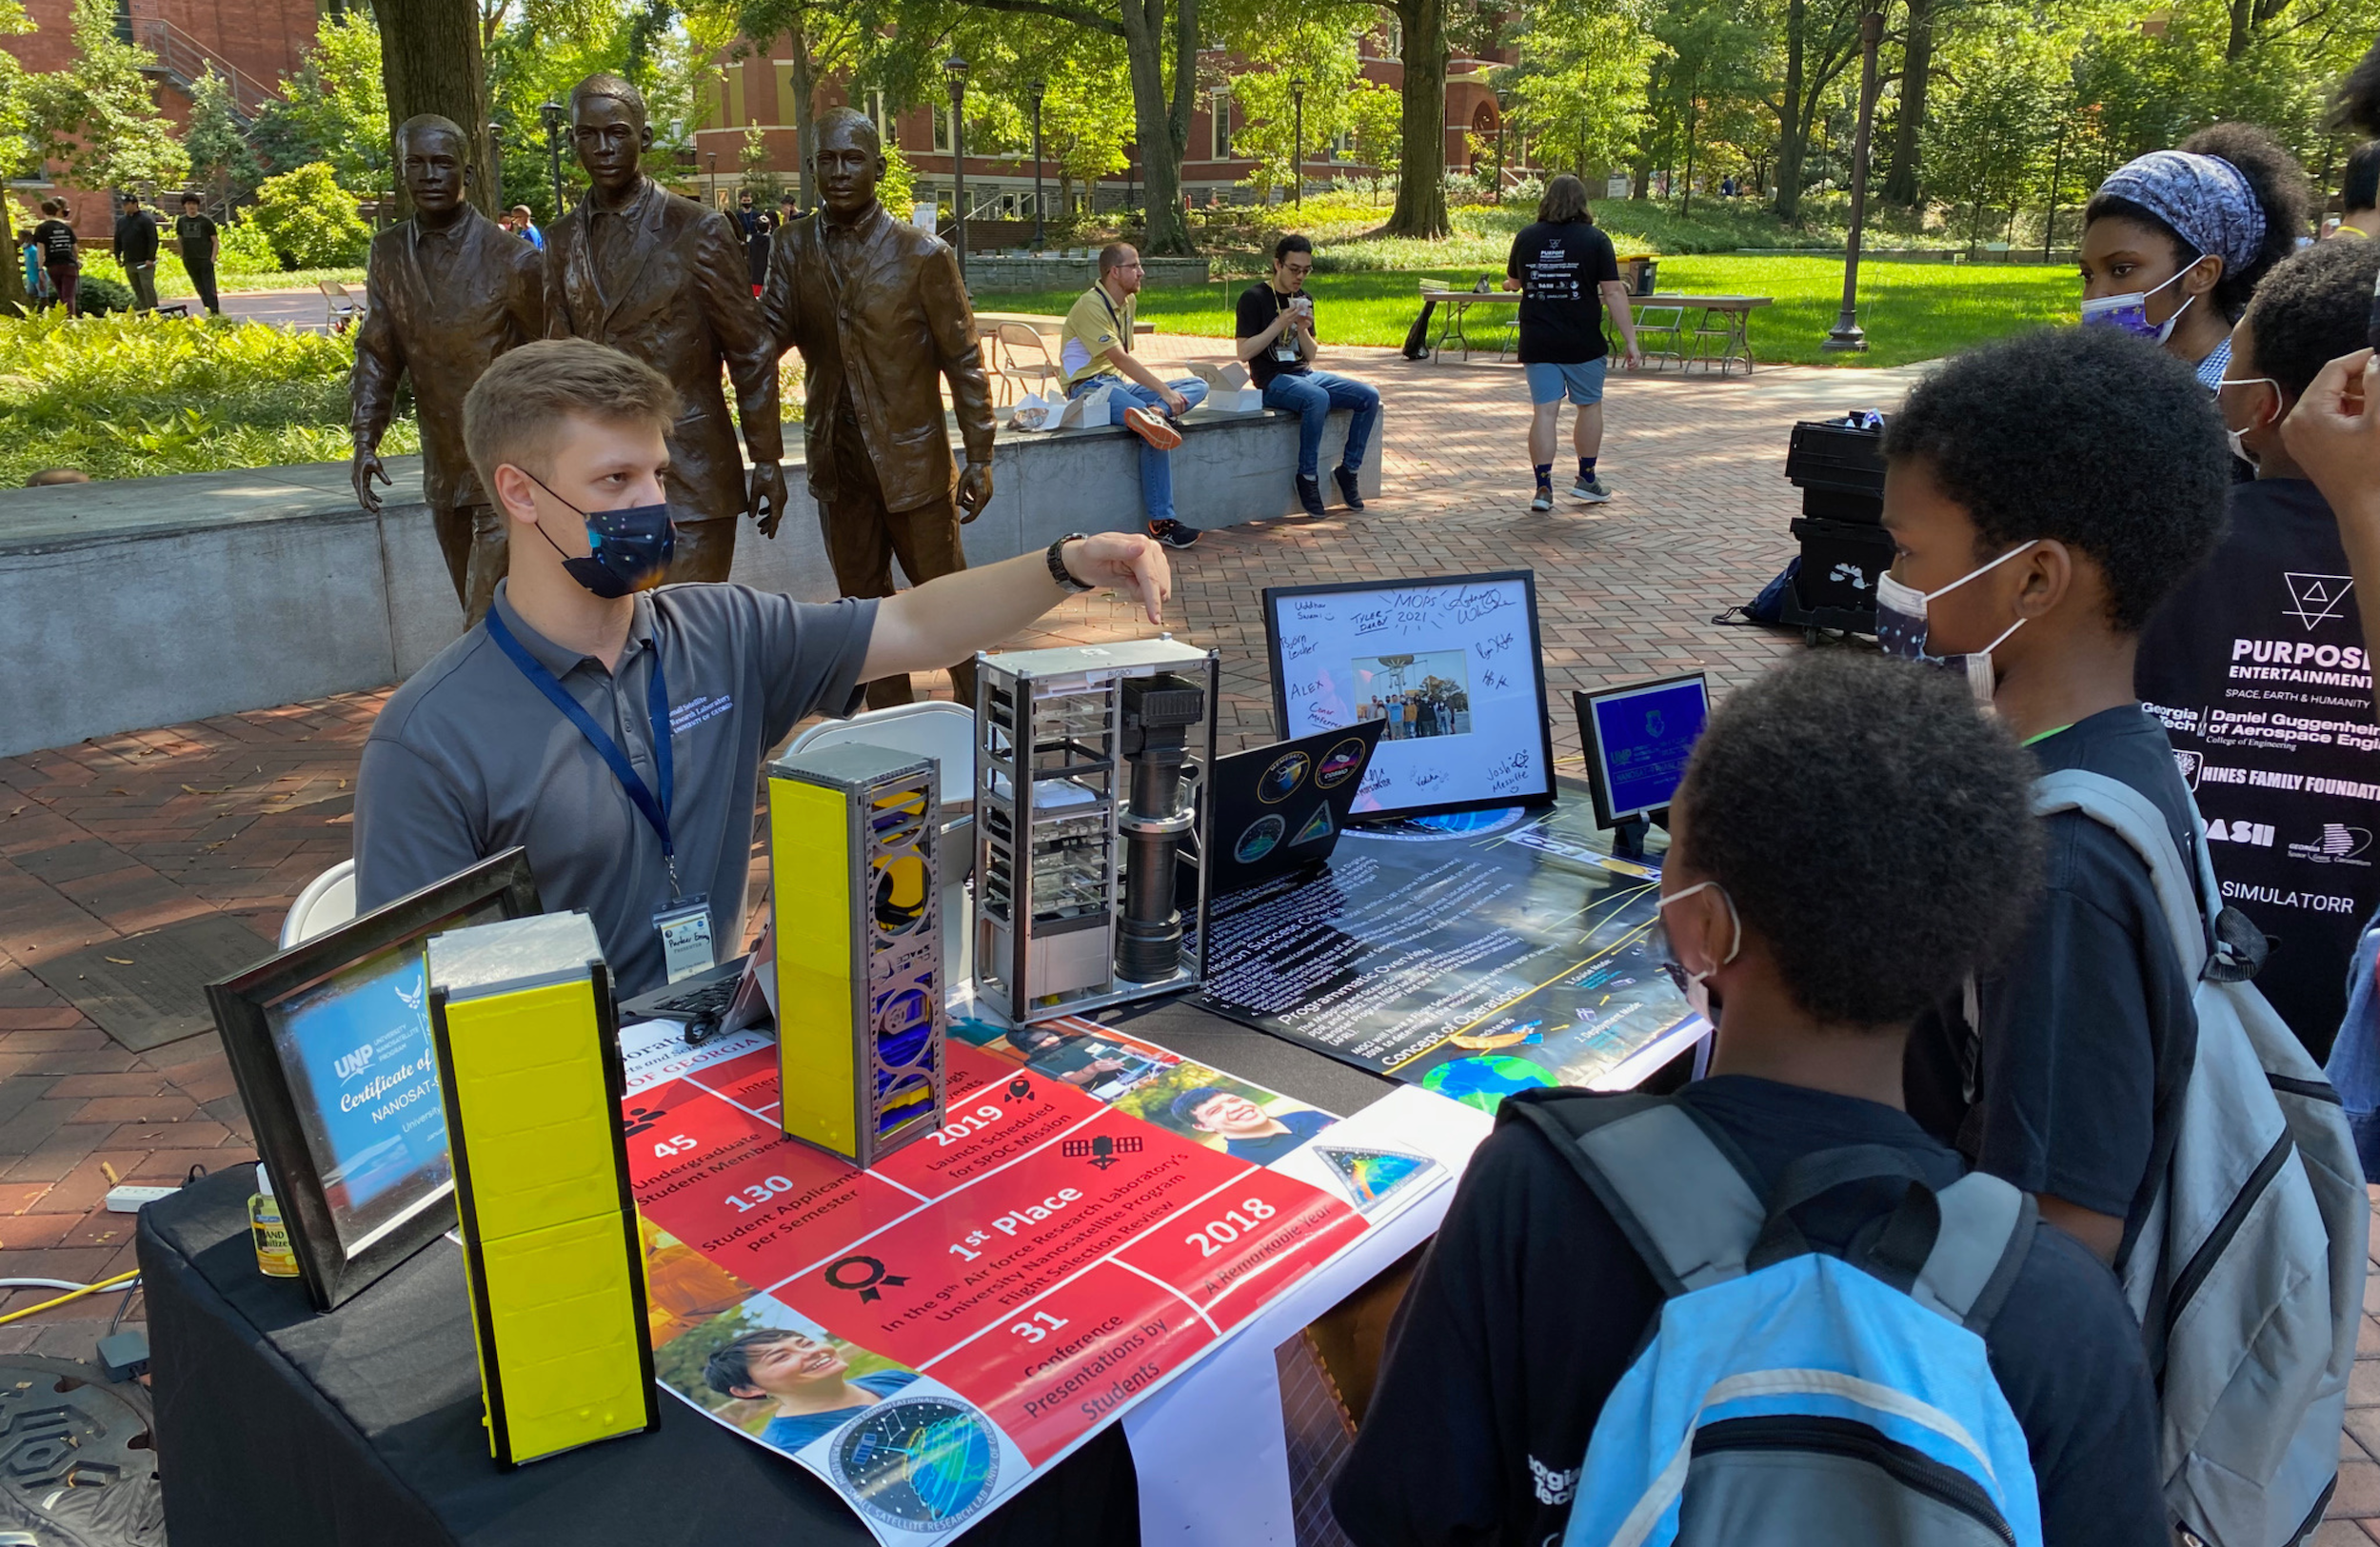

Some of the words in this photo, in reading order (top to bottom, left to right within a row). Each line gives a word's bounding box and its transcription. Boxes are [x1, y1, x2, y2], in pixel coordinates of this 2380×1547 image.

[1394, 593, 1437, 609] MOPS
[1398, 611, 1427, 623] 2021
[1290, 680, 1324, 701] ALEX
[2141, 702, 2198, 721] Georgia
[2211, 709, 2267, 724] Daniel
[2264, 690, 2299, 702] EARTH
[2300, 694, 2309, 703] &
[2311, 695, 2370, 709] HUMANITY
[2159, 716, 2195, 732] Tech
[2209, 724, 2230, 734] of
[2231, 724, 2331, 744] Aerospace
[2206, 736, 2236, 746] College
[2237, 738, 2248, 746] of
[2249, 739, 2296, 753] Engineering
[1486, 761, 1512, 781] Josh
[2202, 766, 2247, 784] HINES
[2249, 769, 2304, 791] FAMILY
[2221, 881, 2354, 914] SIMULATORR
[1247, 923, 1301, 951] Success
[1278, 972, 1378, 1025] Programmatic
[1374, 947, 1434, 973] Overview
[1313, 1002, 1351, 1023] Mapping
[1346, 993, 1363, 1004] and
[1360, 982, 1387, 997] Ocean
[373, 1023, 407, 1045] UNIVERSITY
[1319, 1021, 1356, 1042] Nanosat
[1352, 1002, 1385, 1023] Program
[1404, 983, 1420, 994] and
[1328, 1014, 1345, 1027] and
[1351, 1040, 1374, 1055] MOCI
[1373, 1029, 1388, 1043] will
[1385, 1020, 1409, 1034] have
[1462, 974, 1490, 991] Review
[1381, 1030, 1444, 1065] Concept
[1440, 1021, 1458, 1035] of
[1454, 986, 1525, 1025] Operations
[1393, 1016, 1433, 1042] determine
[1449, 993, 1477, 1009] mission
[333, 1043, 374, 1079] UNP
[340, 1063, 415, 1113] Certificate
[416, 1047, 433, 1072] of
[626, 1072, 656, 1087] OF
[663, 1038, 760, 1074] GEORGIA
[645, 1054, 670, 1067] and
[402, 1105, 441, 1133] University
[925, 1105, 1003, 1147] 2019
[926, 1144, 983, 1171] Launch
[981, 1103, 1056, 1146] Scheduled
[632, 1132, 762, 1190] Undergraduate
[653, 1134, 698, 1159] 45
[948, 1164, 975, 1179] for
[973, 1144, 1018, 1167] SPOC
[1014, 1113, 1072, 1148] Mission
[637, 1172, 708, 1206] Student
[711, 1136, 792, 1173] Members
[724, 1175, 794, 1213] 130
[702, 1213, 776, 1253] Student
[776, 1170, 863, 1217] Applicants
[746, 1229, 778, 1253] per
[779, 1187, 860, 1234] Semester
[949, 1229, 990, 1262] 1st
[991, 1187, 1083, 1236] Place
[1184, 1198, 1276, 1258] 2018
[881, 1317, 903, 1333] In
[903, 1298, 938, 1322] the
[936, 1283, 960, 1304] 9th
[963, 1268, 990, 1287] Air
[988, 1244, 1035, 1275] force
[1035, 1201, 1103, 1246] Research
[1103, 1152, 1189, 1205] Laboratory's
[935, 1269, 1023, 1322] University
[1021, 1210, 1122, 1272] Nanosatellite
[1122, 1173, 1186, 1213] Program
[999, 1276, 1050, 1306] Flight
[1046, 1233, 1121, 1278] Selection
[1120, 1200, 1174, 1235] Review
[1204, 1279, 1220, 1296] A
[1218, 1223, 1302, 1285] Remarkable
[1299, 1203, 1332, 1235] Year
[1011, 1310, 1069, 1344] 31
[1024, 1314, 1124, 1378] Conference
[1023, 1335, 1146, 1418] Presentations
[1145, 1317, 1169, 1340] by
[1081, 1360, 1160, 1421] Students
[863, 1397, 934, 1419] COMPUTATIONAL
[937, 1397, 969, 1413] IMAGER
[846, 1487, 871, 1512] SMALL
[874, 1509, 924, 1532] SATELLITE
[927, 1507, 973, 1532] RESEARCH
[972, 1489, 988, 1509] LAB
[990, 1447, 999, 1459] OF
